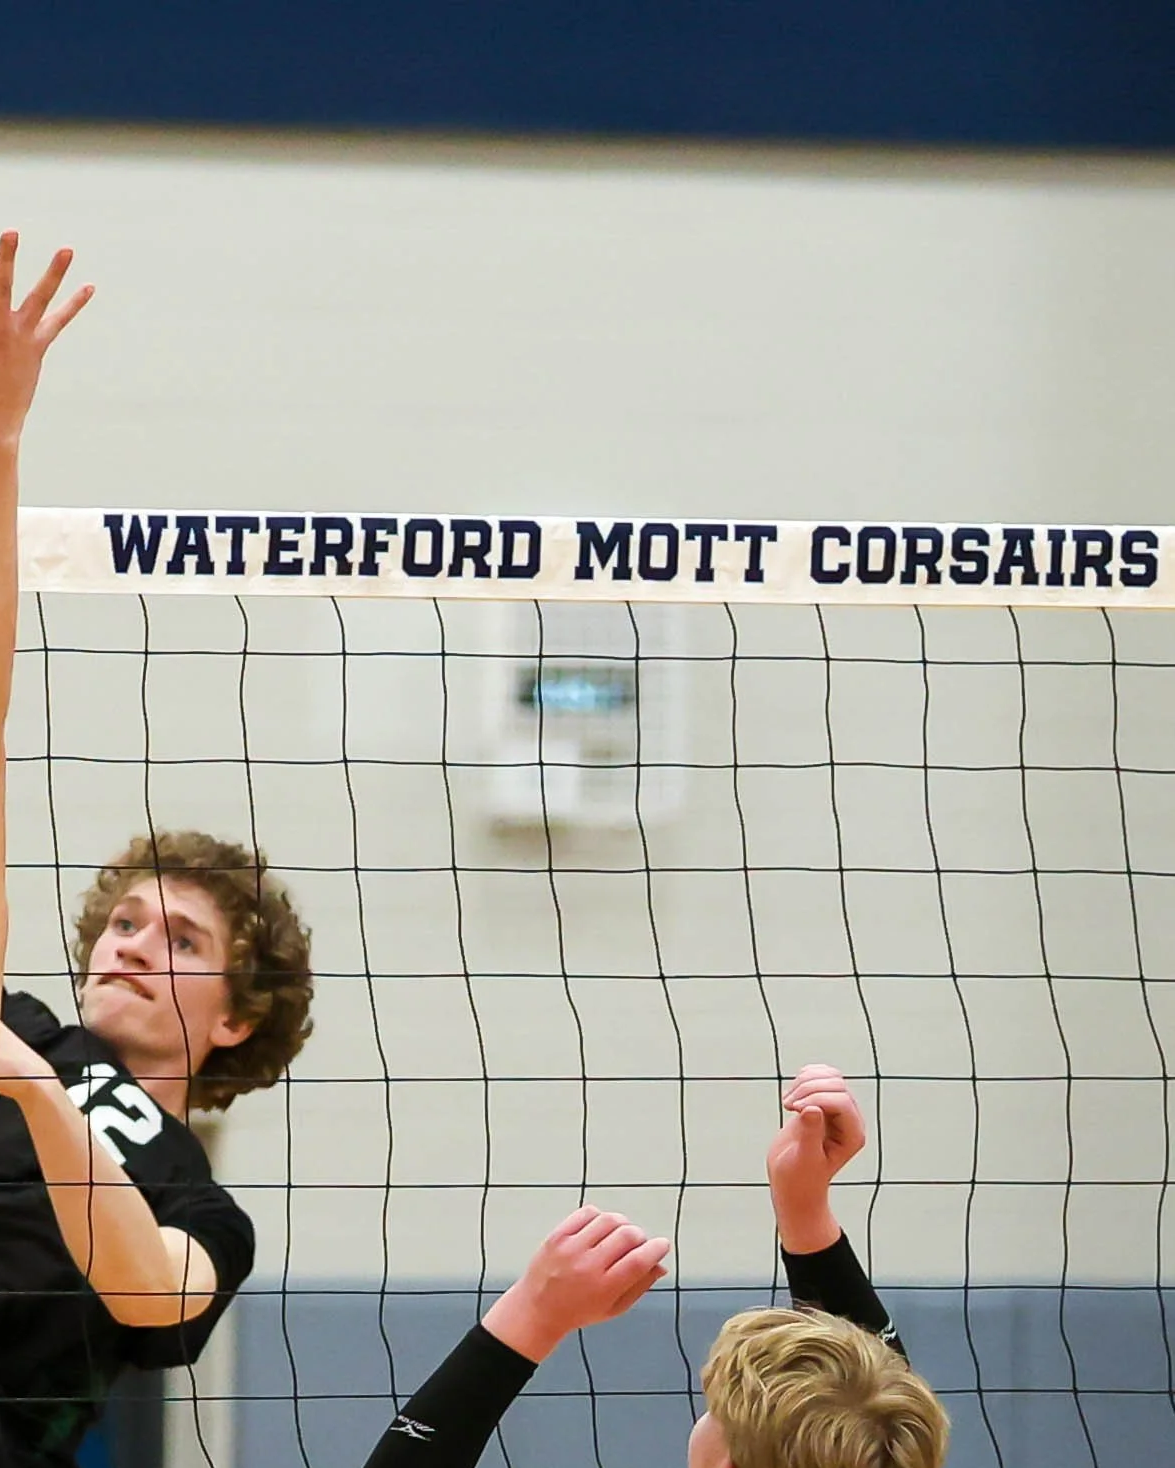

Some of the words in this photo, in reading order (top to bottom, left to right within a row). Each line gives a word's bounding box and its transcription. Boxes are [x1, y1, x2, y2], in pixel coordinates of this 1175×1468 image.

[103, 514, 542, 579] WATERFORD
[574, 521, 778, 583] MOTT
[810, 525, 1159, 588] CORSAIRS
